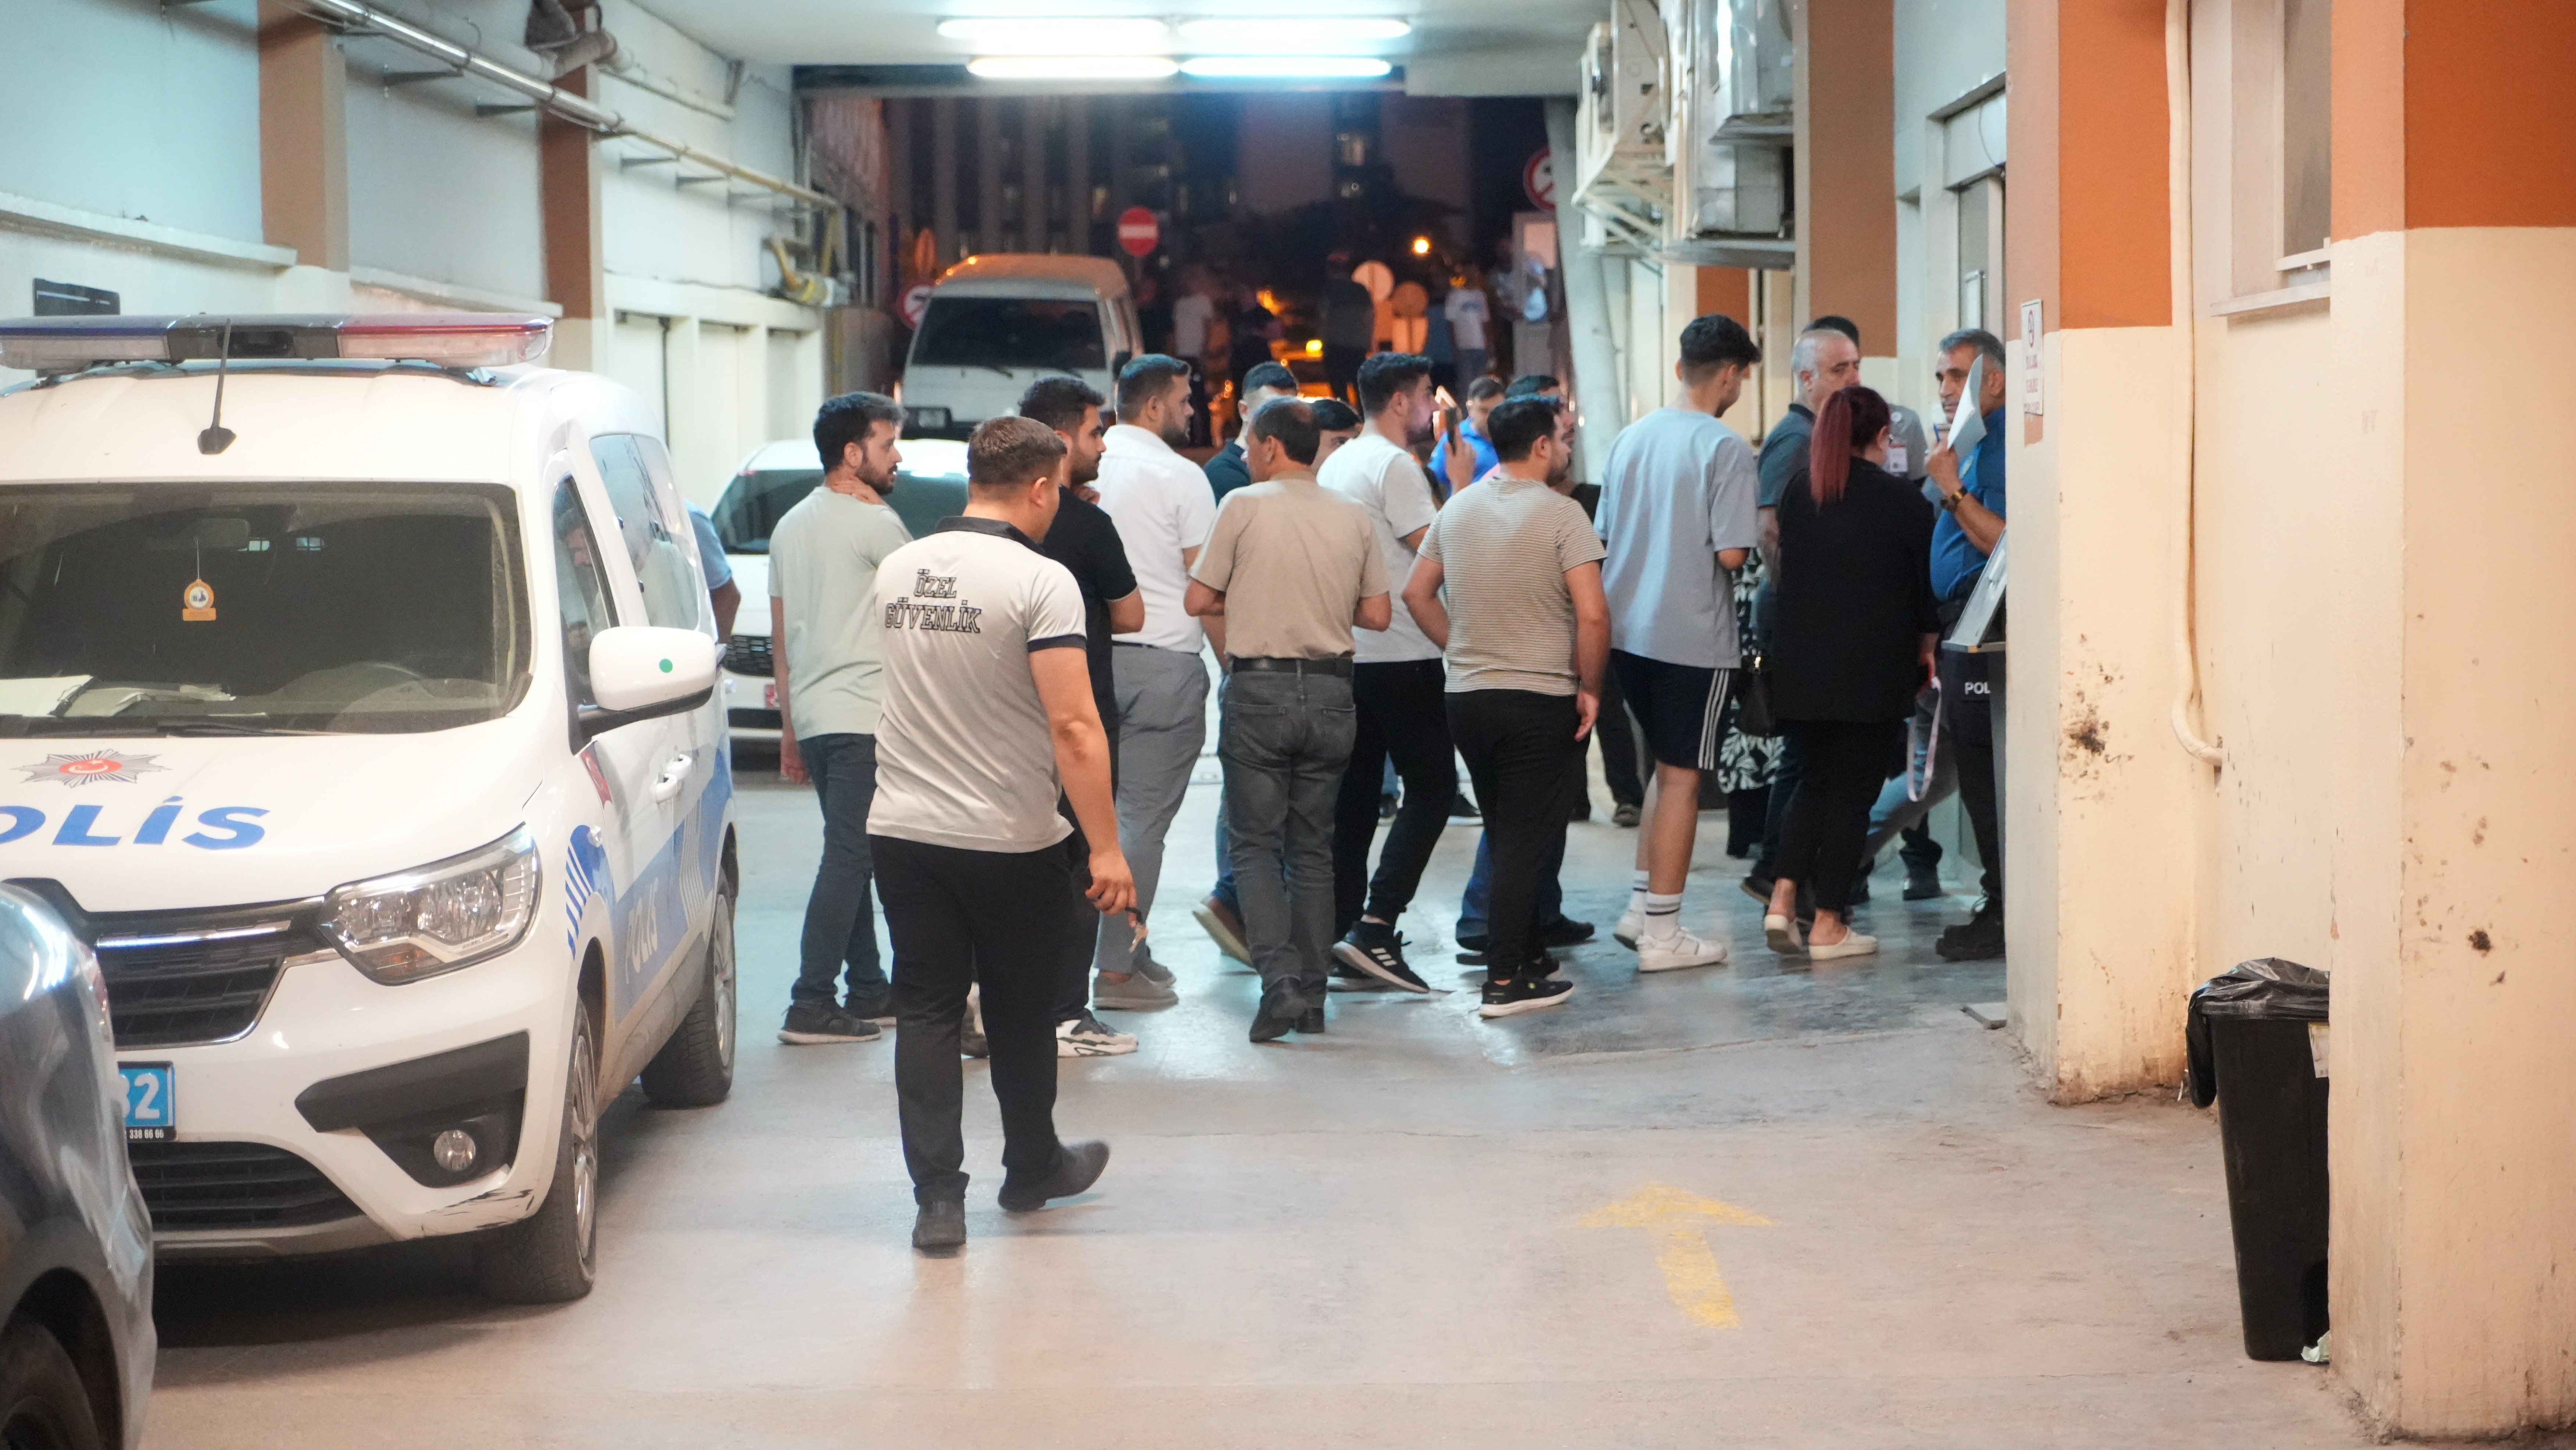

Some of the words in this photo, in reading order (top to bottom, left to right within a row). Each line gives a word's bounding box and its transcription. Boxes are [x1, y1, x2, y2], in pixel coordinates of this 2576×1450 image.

[913, 569, 957, 598] ÖZEL
[885, 597, 981, 633] GÜVENLİK
[1964, 681, 1991, 695] POL
